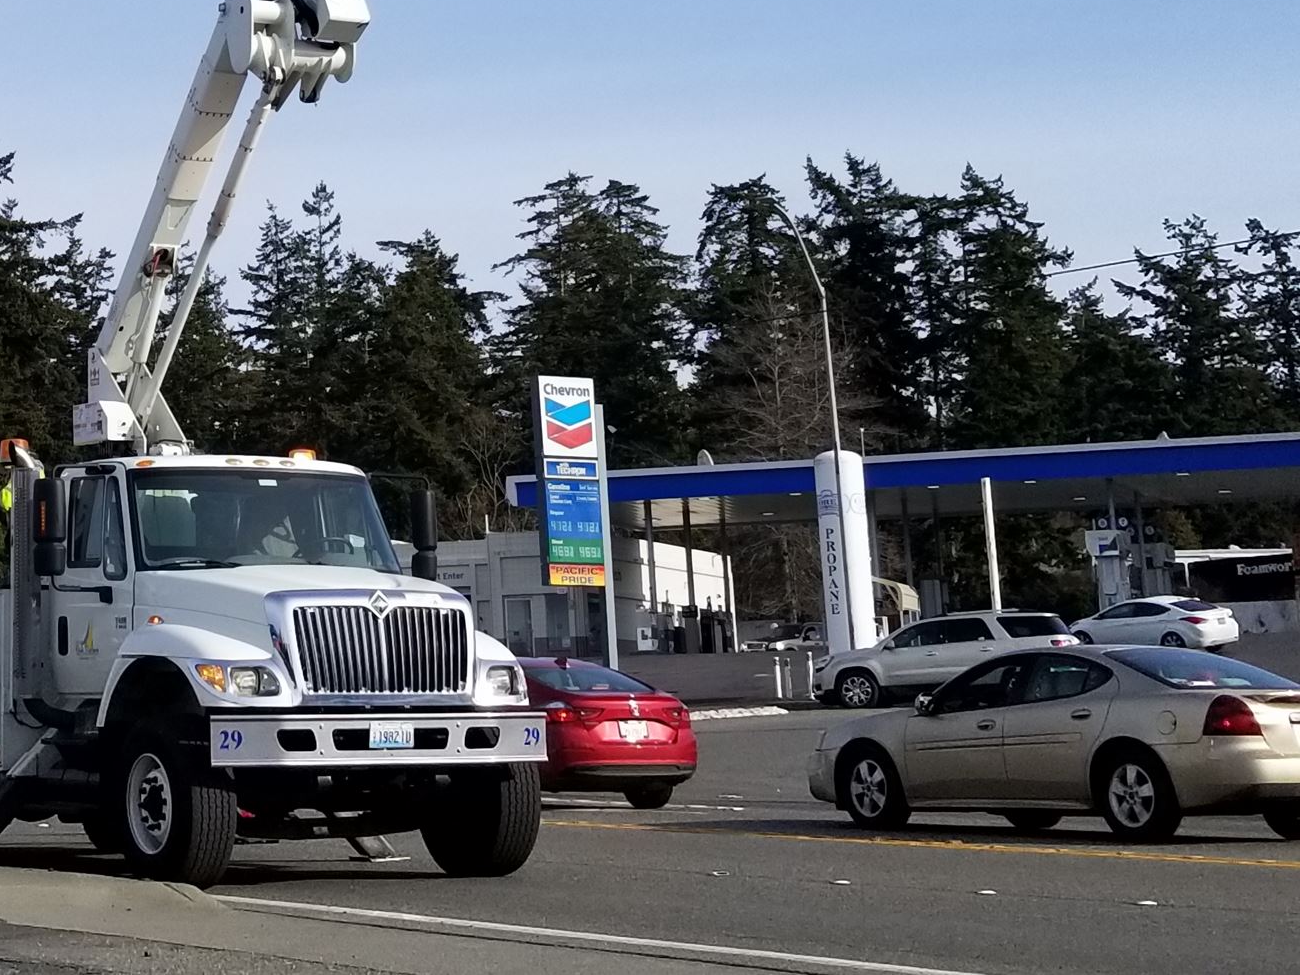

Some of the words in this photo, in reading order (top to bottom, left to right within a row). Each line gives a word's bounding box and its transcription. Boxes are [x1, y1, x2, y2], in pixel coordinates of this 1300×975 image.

[543, 383, 591, 397] Chevron
[555, 567, 598, 575] PACIFIC
[825, 528, 841, 615] PROPANE
[561, 576, 594, 584] PRIDE
[220, 730, 242, 750] 29
[524, 727, 540, 745] 29
